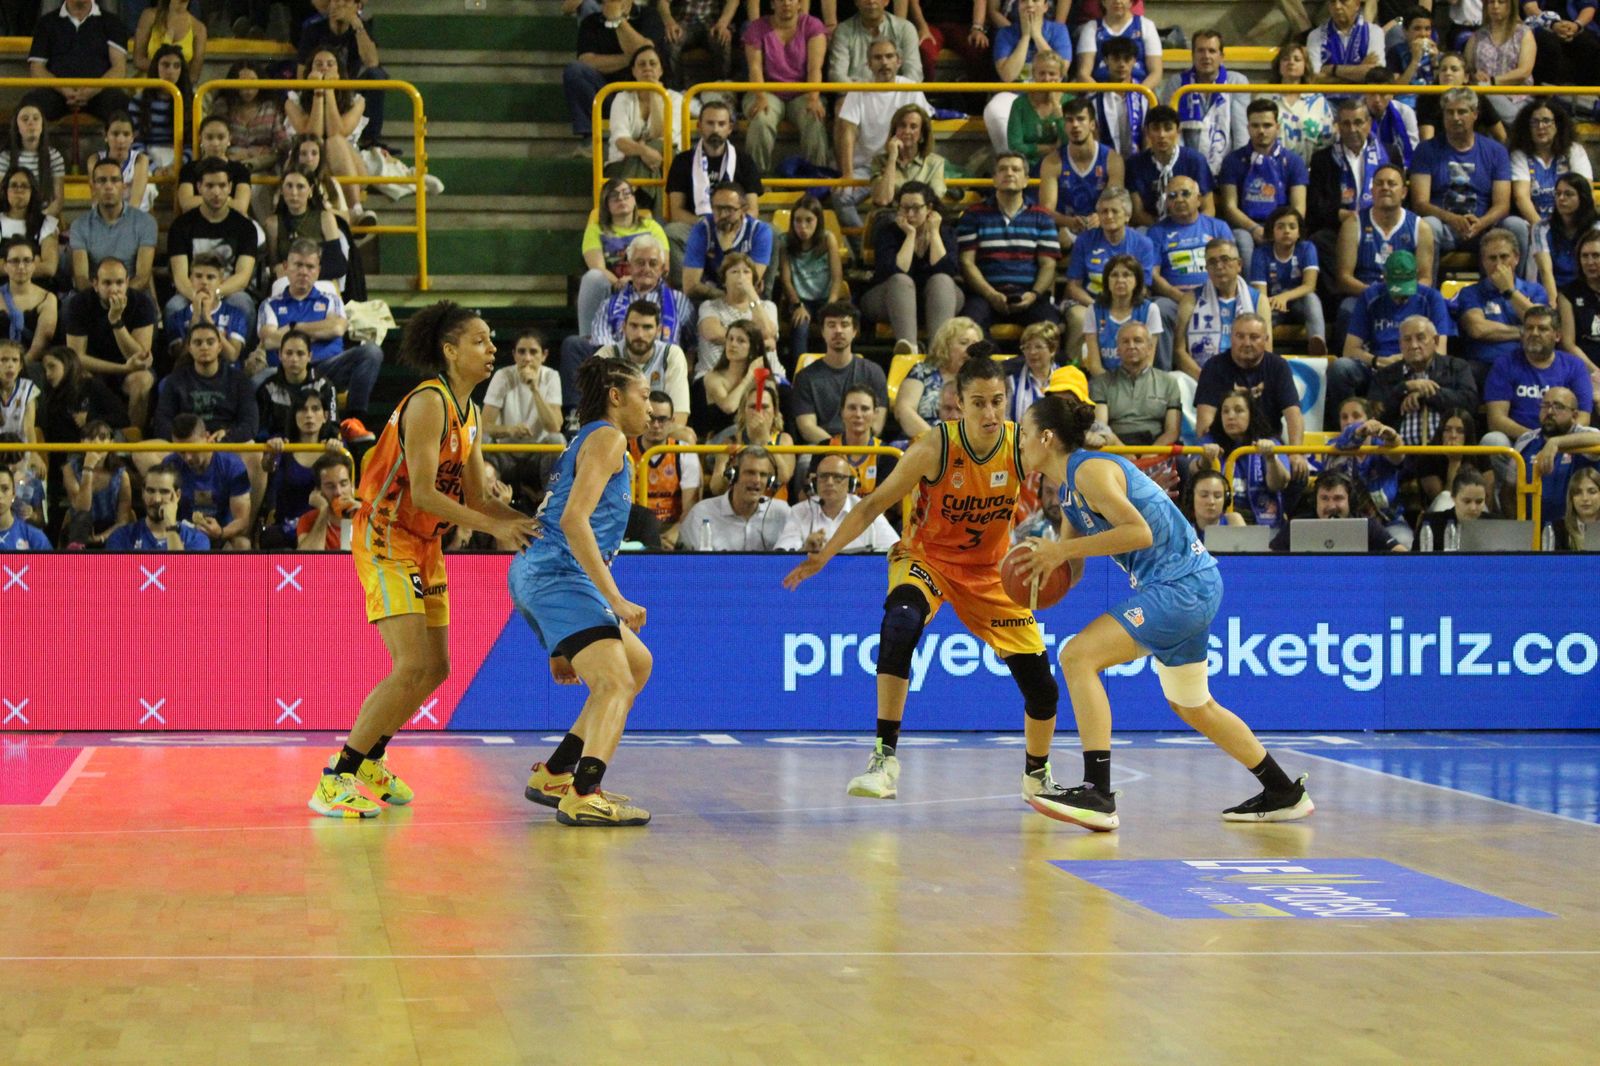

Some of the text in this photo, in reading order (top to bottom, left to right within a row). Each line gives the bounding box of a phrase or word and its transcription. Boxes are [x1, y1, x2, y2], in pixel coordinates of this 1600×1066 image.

[942, 494, 1005, 511] Cultura
[958, 527, 982, 550] 3
[991, 616, 1034, 627] zummo
